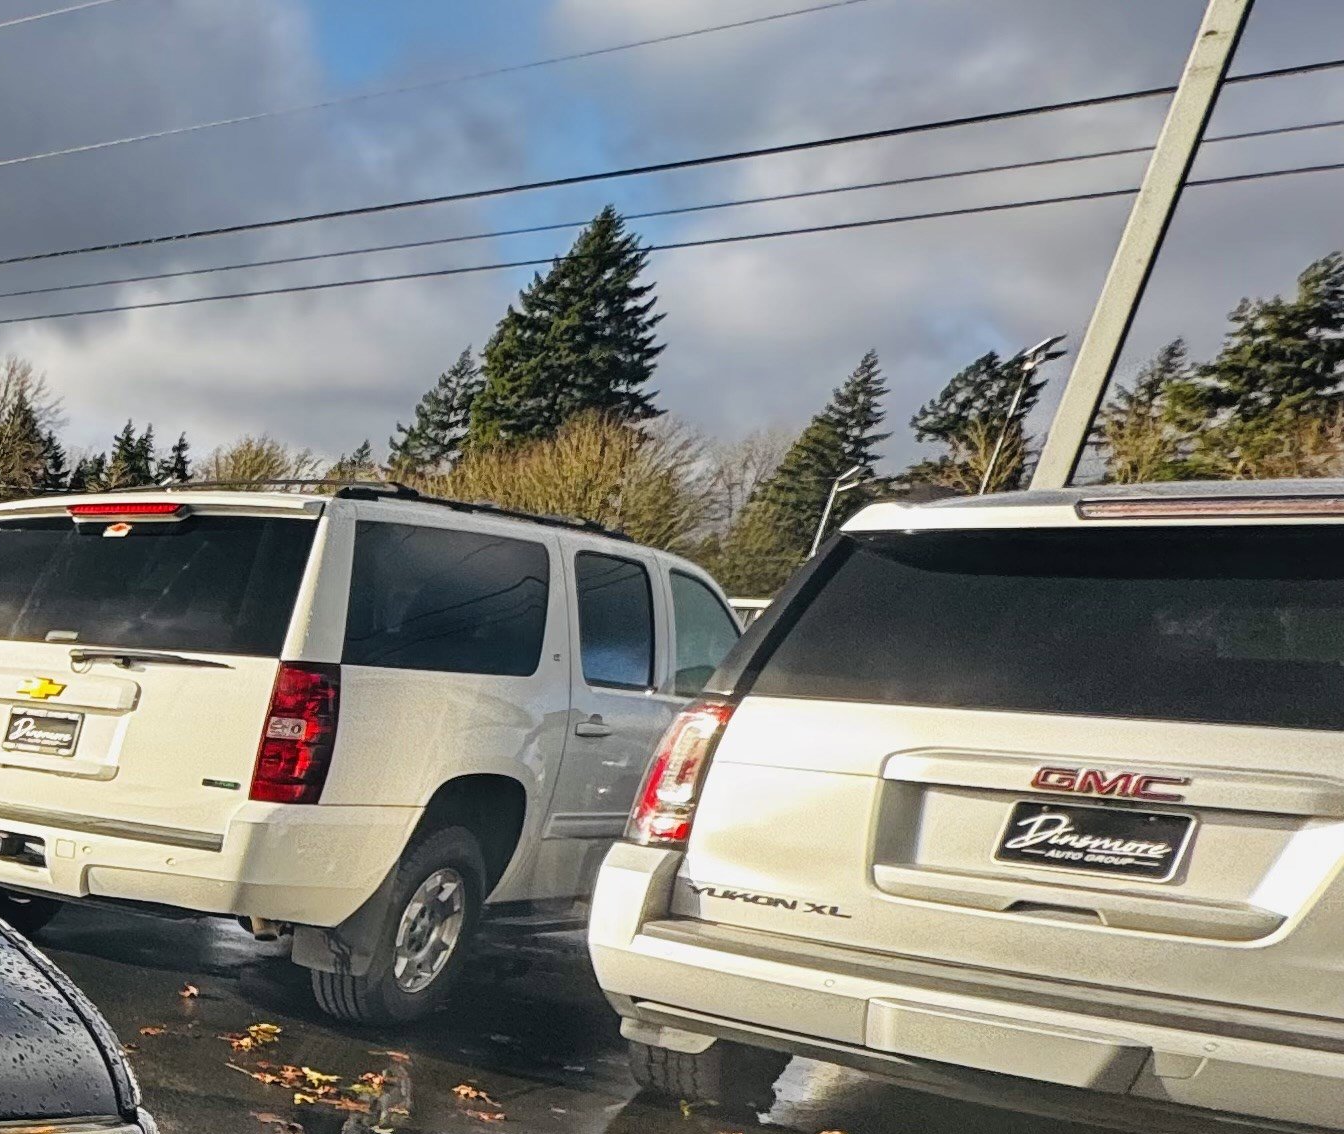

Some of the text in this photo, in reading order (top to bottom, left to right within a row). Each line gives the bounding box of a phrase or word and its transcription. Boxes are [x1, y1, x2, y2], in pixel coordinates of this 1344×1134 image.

[1031, 767, 1192, 802] GMC
[1005, 813, 1172, 857] Dinsmore
[1044, 850, 1136, 866] AUTO GROUP
[688, 884, 852, 918] YUKON XL
